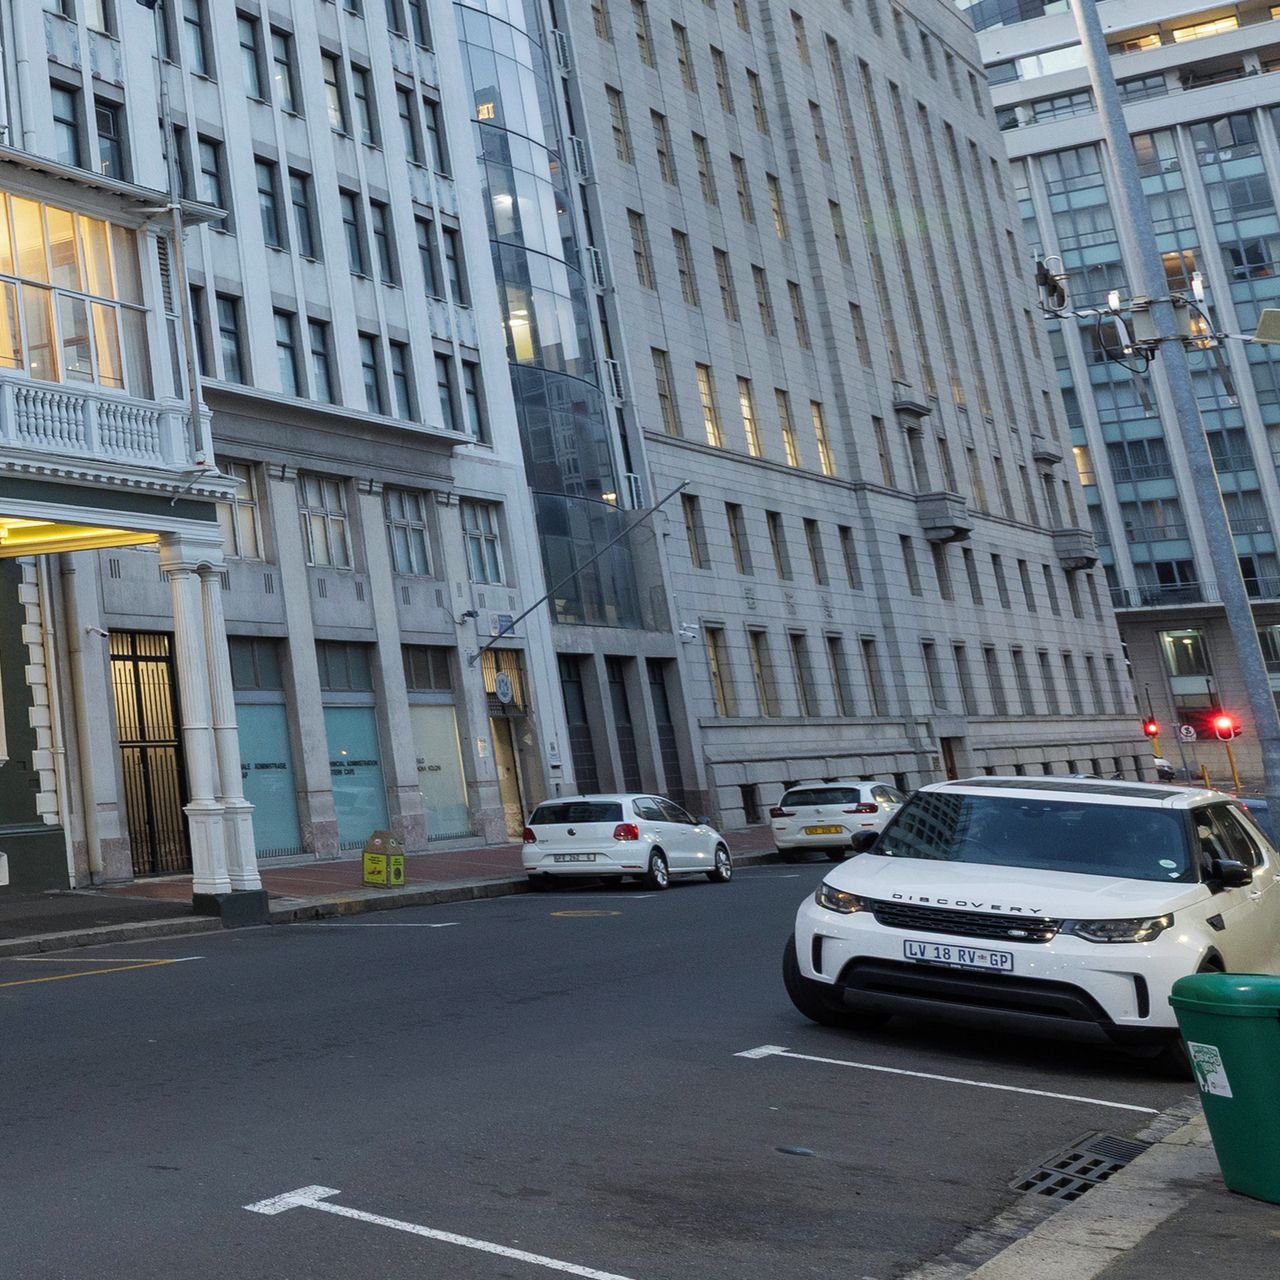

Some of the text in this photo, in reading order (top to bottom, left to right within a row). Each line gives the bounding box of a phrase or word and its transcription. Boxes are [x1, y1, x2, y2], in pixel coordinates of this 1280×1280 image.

[892, 893, 1042, 914] DISCOVERY
[909, 943, 926, 958] LV
[934, 947, 951, 961] 18
[958, 949, 975, 963] RV
[990, 953, 1008, 967] GP
